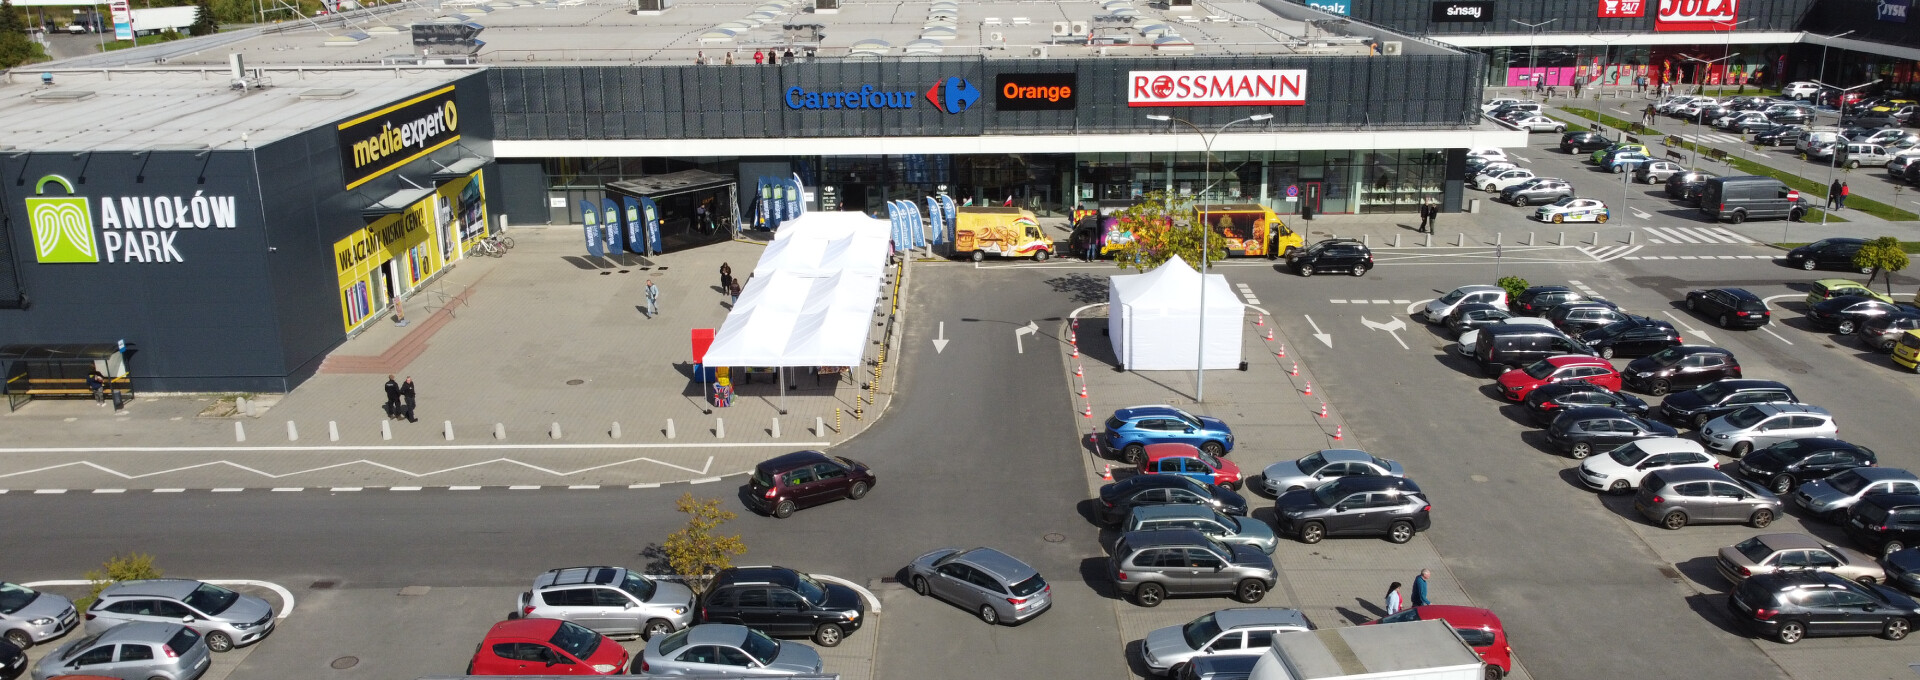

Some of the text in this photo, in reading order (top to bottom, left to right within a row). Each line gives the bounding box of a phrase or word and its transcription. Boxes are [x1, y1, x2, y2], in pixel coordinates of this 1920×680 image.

[1447, 5, 1481, 18] sinsay
[1621, 2, 1640, 11] 24/7
[1660, 0, 1735, 17] JULA
[1882, 3, 1907, 17] JYSK
[785, 84, 917, 110] Carrefour
[1003, 82, 1071, 102] Orange
[1134, 74, 1301, 99] ROSSMANN
[353, 105, 446, 169] mediaexpert
[101, 189, 237, 229] ANIOŁÓW
[103, 230, 184, 263] PARK
[338, 230, 381, 271] WŁĄCZAMY
[405, 207, 425, 233] CENY!
